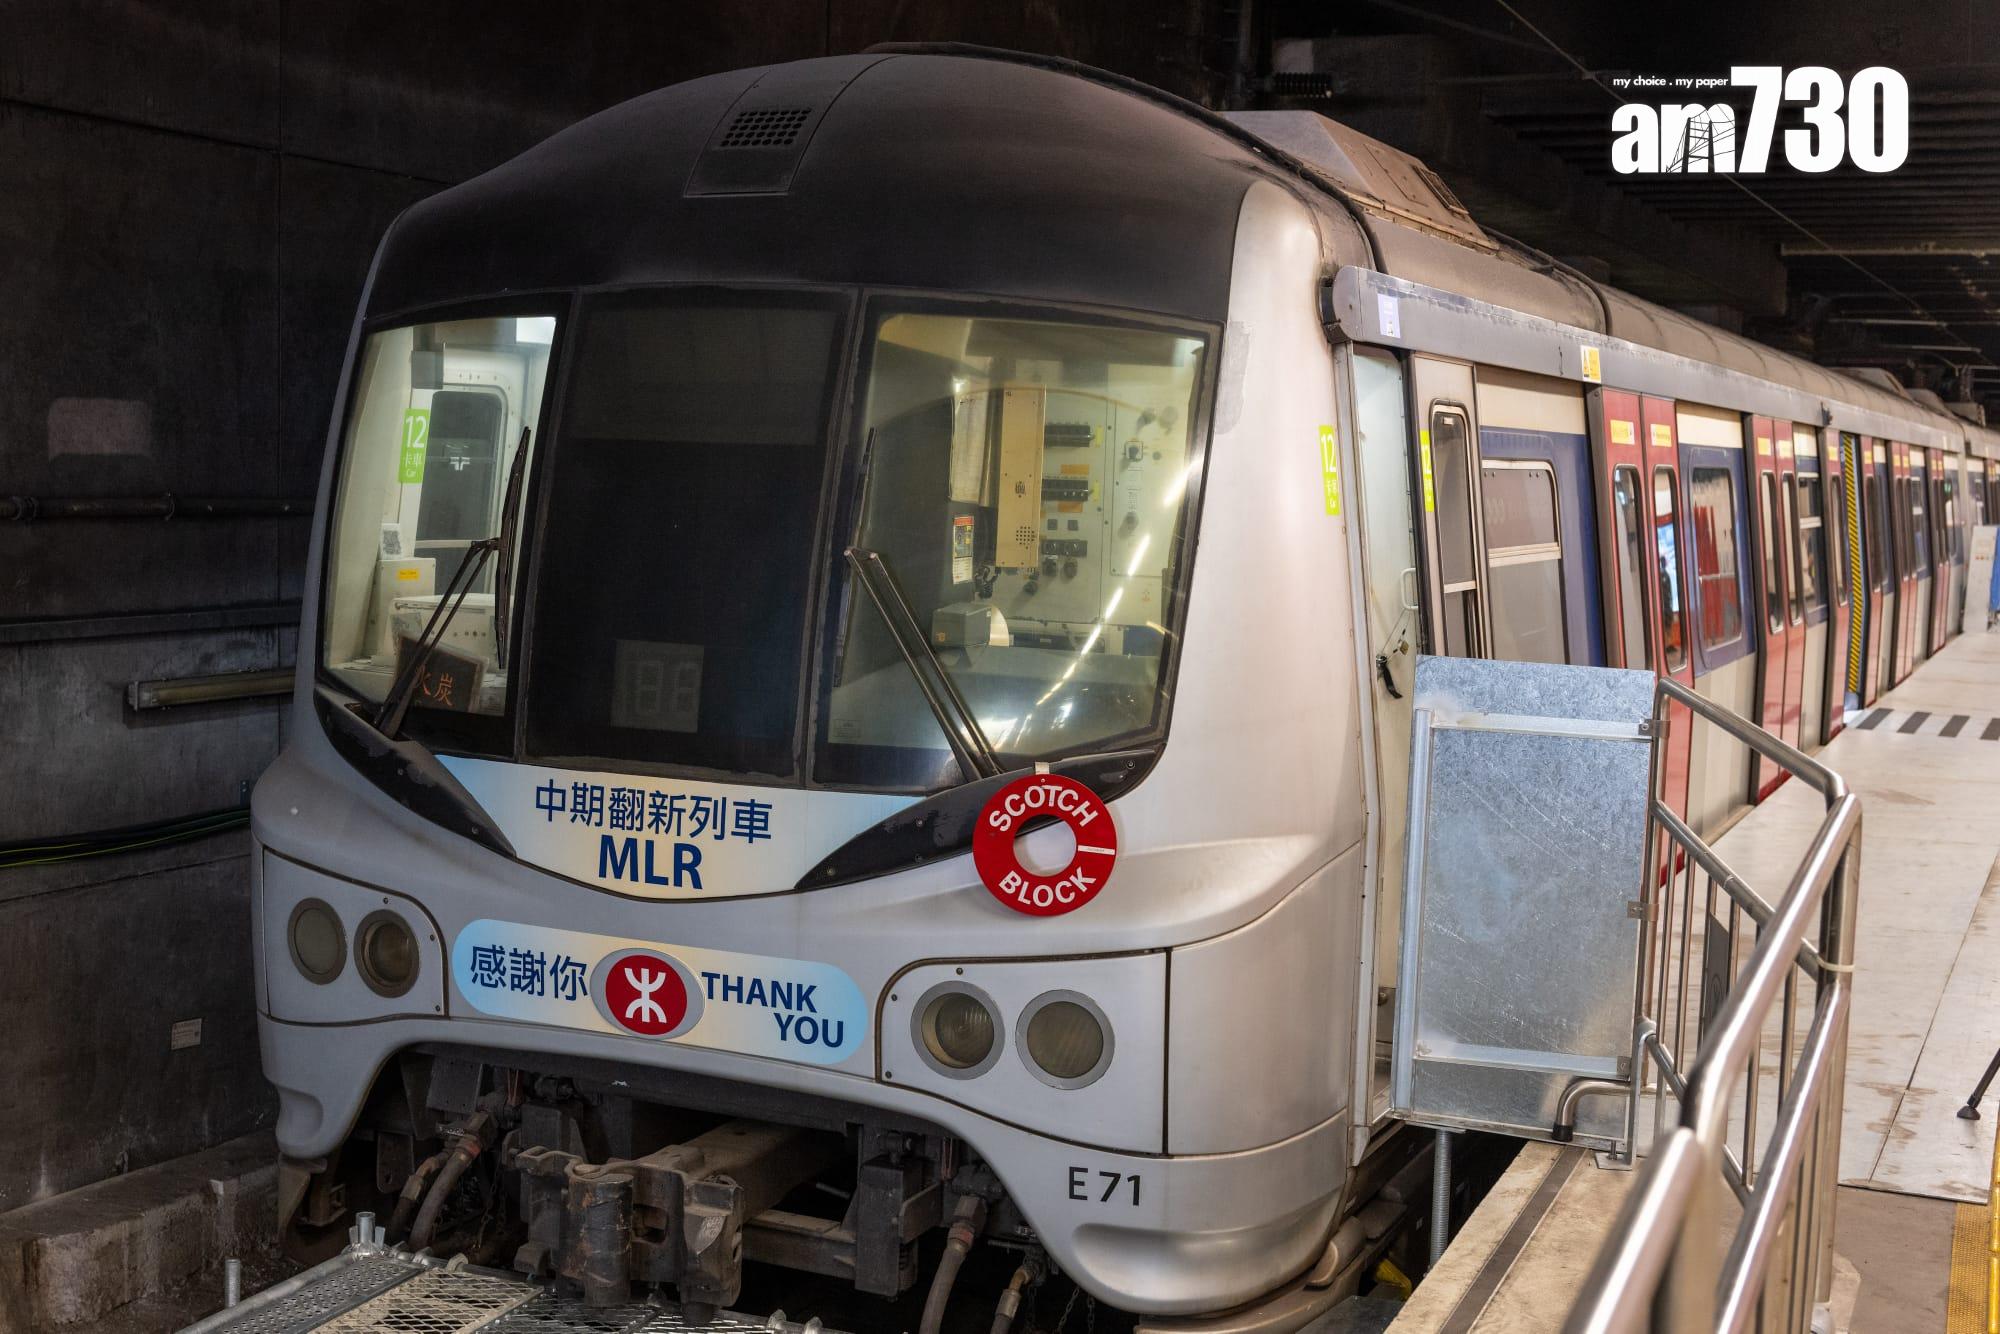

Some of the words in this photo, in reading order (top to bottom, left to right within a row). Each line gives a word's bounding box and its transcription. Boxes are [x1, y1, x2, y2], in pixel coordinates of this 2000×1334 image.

[405, 415, 427, 449] 12
[1319, 433, 1337, 473] 12
[536, 779, 773, 844] 中期翻新列車
[989, 785, 1099, 832] SCOTCH
[598, 834, 703, 890] MLR
[998, 866, 1097, 907] BLOCK
[470, 944, 588, 1002] 感謝你
[701, 970, 817, 1013] THANK
[773, 1012, 844, 1048] YOU
